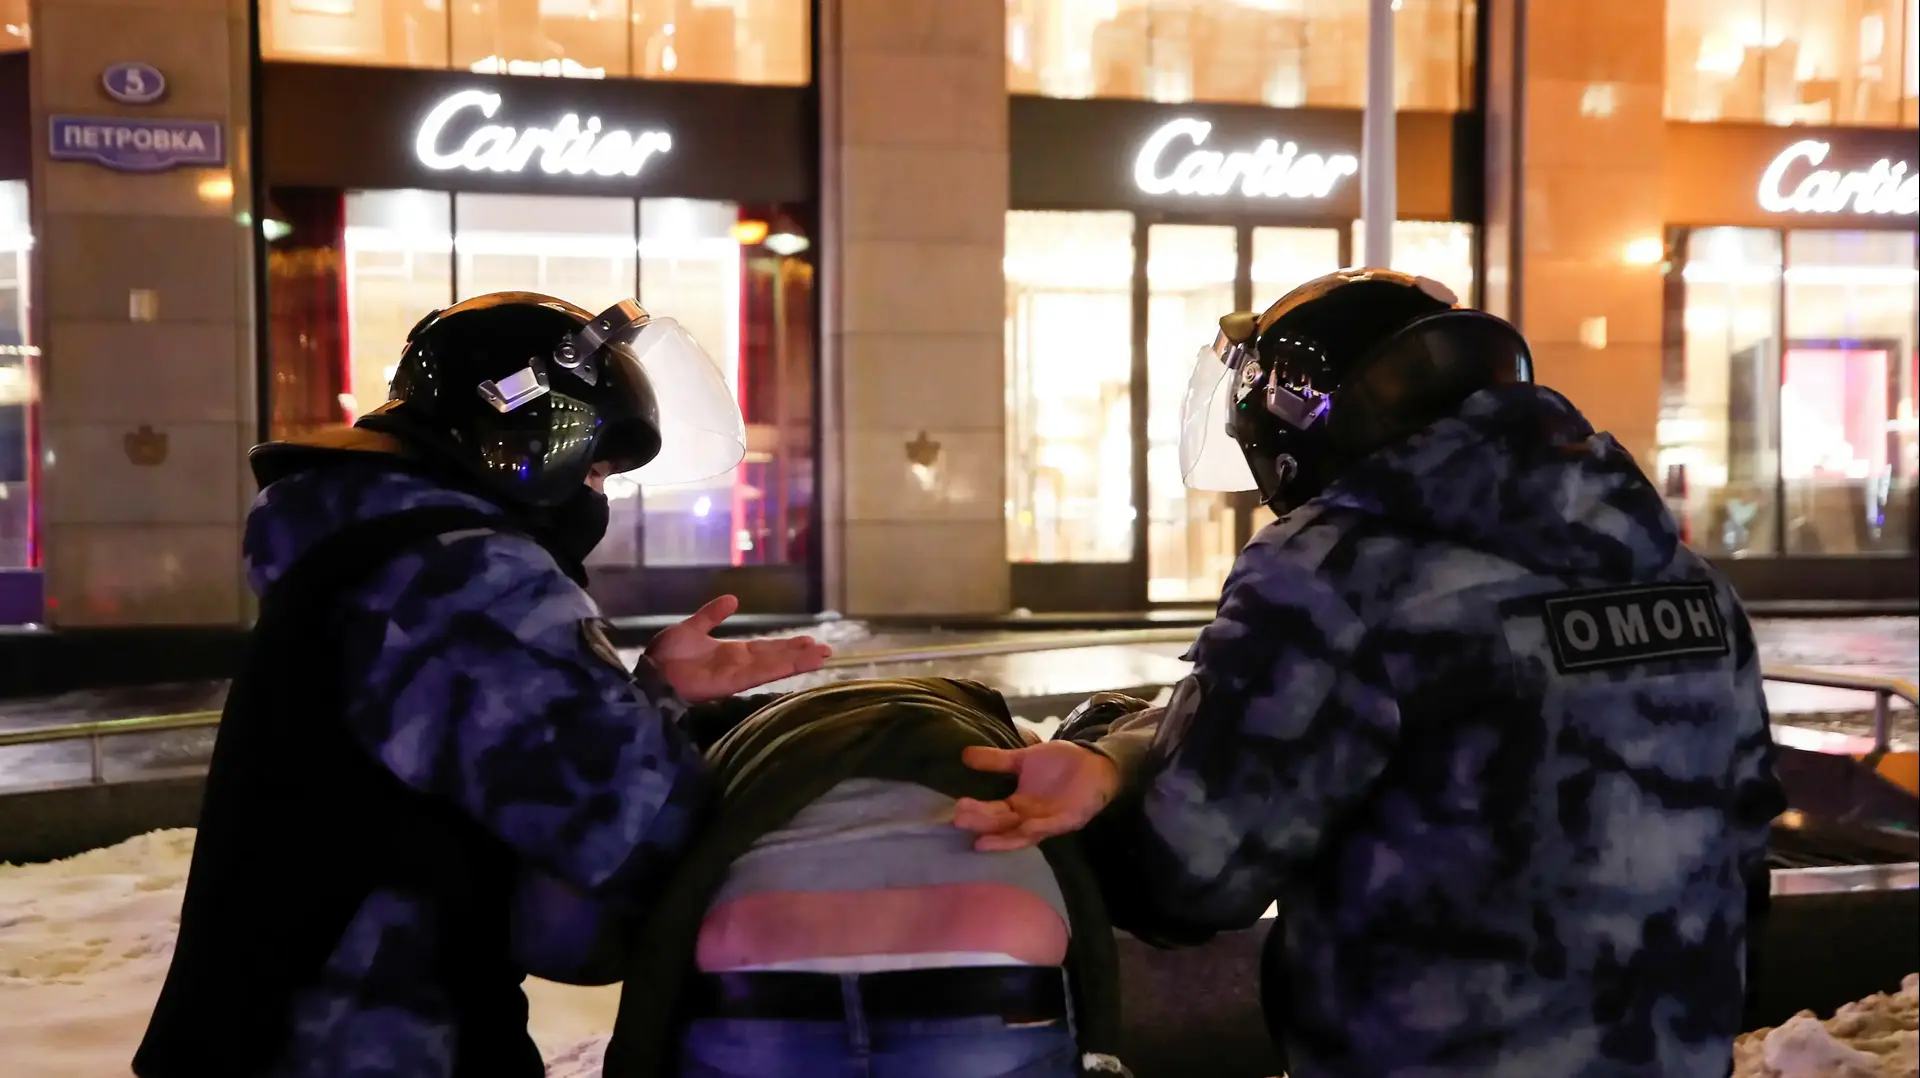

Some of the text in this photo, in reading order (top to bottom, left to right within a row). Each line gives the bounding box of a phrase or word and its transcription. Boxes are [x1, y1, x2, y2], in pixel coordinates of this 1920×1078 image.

[125, 69, 144, 95] 5
[64, 125, 206, 152] ПЕТРОВКА
[416, 90, 672, 176] Cartier
[1134, 118, 1359, 198] Cartier
[1563, 599, 1715, 651] ОМОН
